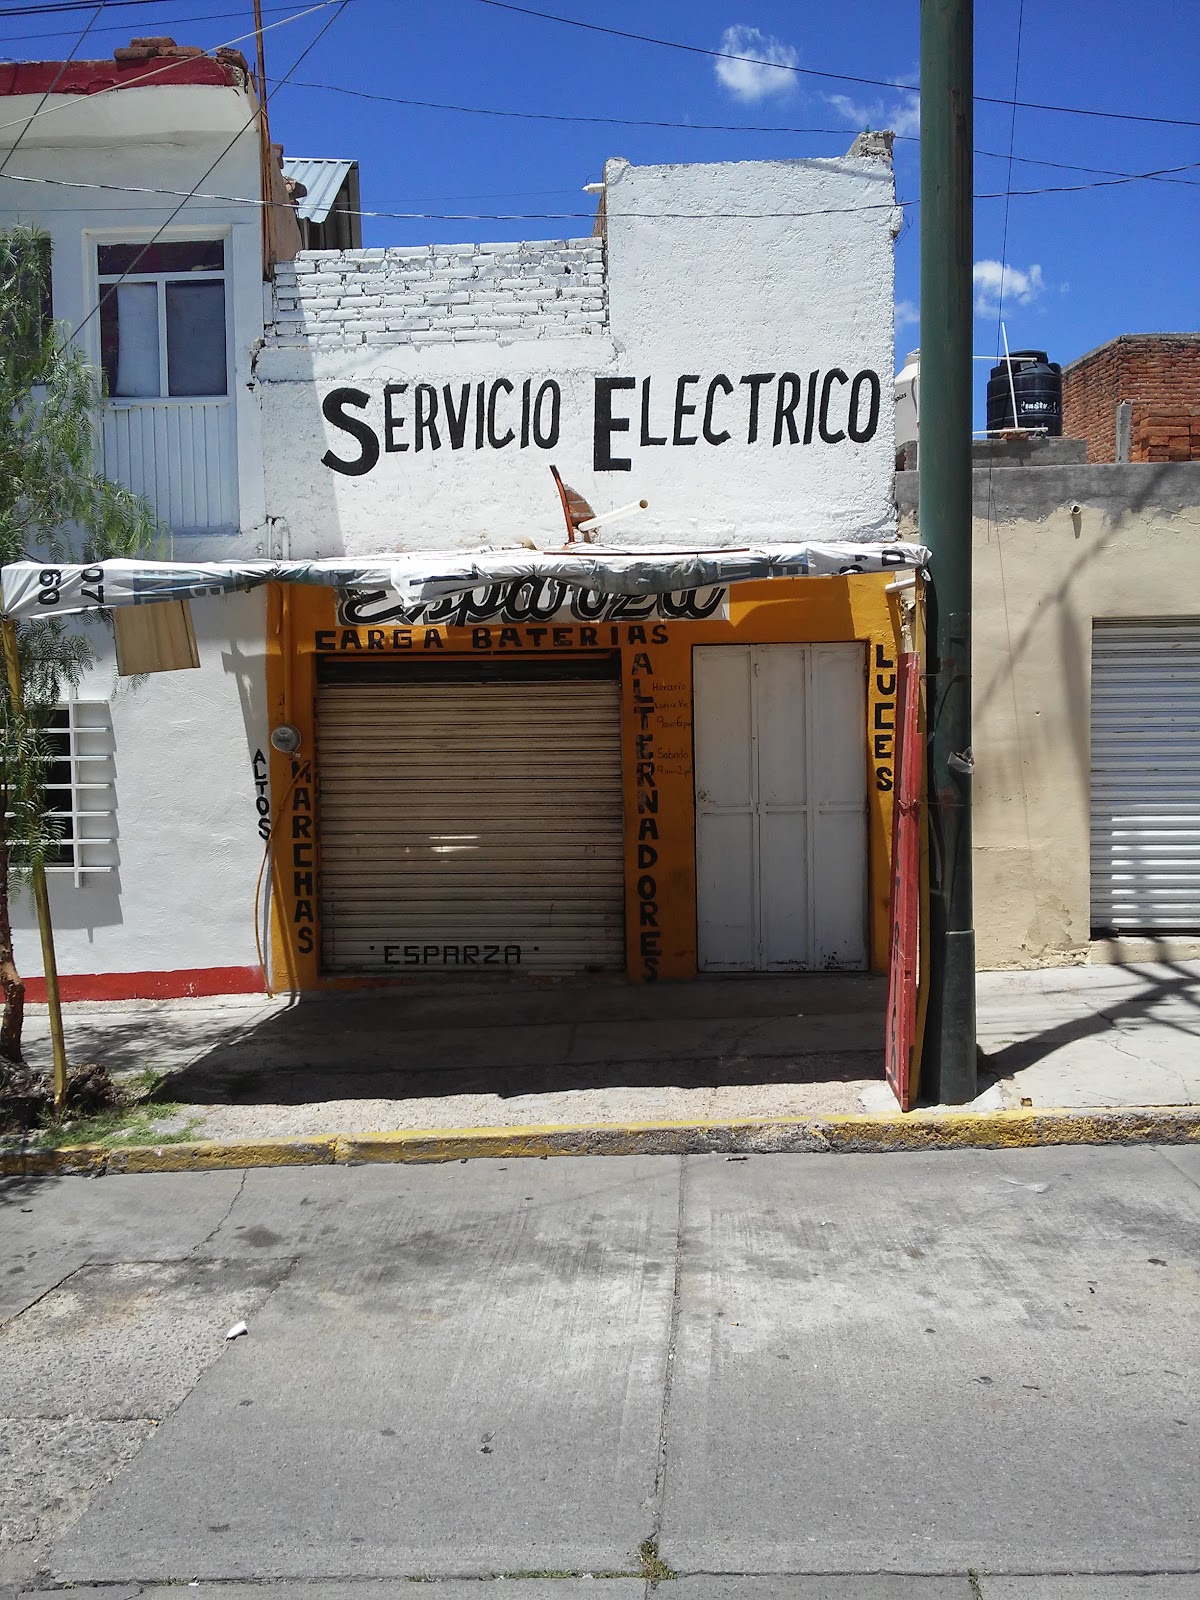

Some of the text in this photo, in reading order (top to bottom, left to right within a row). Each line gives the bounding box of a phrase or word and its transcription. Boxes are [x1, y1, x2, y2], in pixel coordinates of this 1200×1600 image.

[320, 368, 881, 476] SERVICIO ELECTRICO
[315, 625, 669, 651] CARGA BATERIAS
[652, 682, 686, 692] Horario
[874, 643, 896, 792] LUCES
[252, 748, 271, 841] ALTOS
[657, 747, 689, 759] Sabado
[291, 760, 314, 954] MARCHAS
[631, 652, 662, 983] ALTERNADORES
[384, 945, 522, 965] ESPARZA
